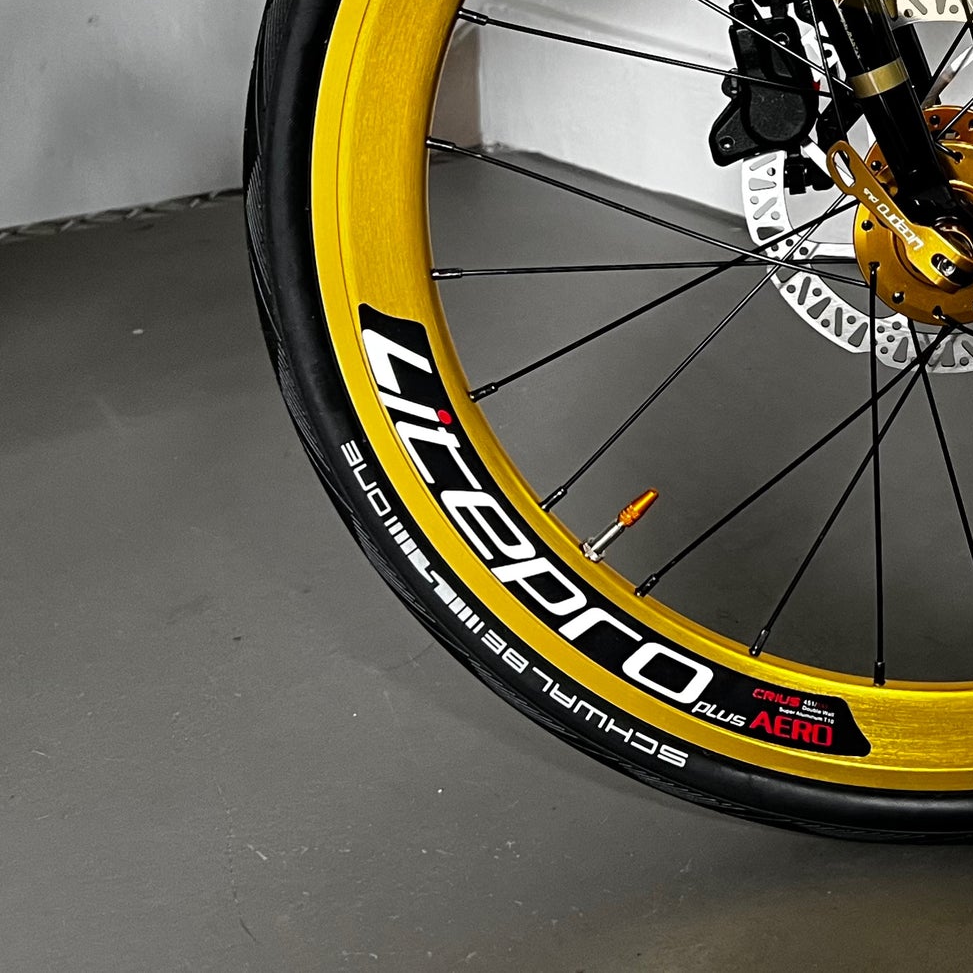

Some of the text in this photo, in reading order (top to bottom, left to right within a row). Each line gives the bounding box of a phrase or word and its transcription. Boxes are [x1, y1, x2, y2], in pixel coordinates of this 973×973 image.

[340, 440, 689, 768] SCHWALBE ONE
[752, 688, 801, 708] CRIUS
[749, 711, 833, 747] AERO
